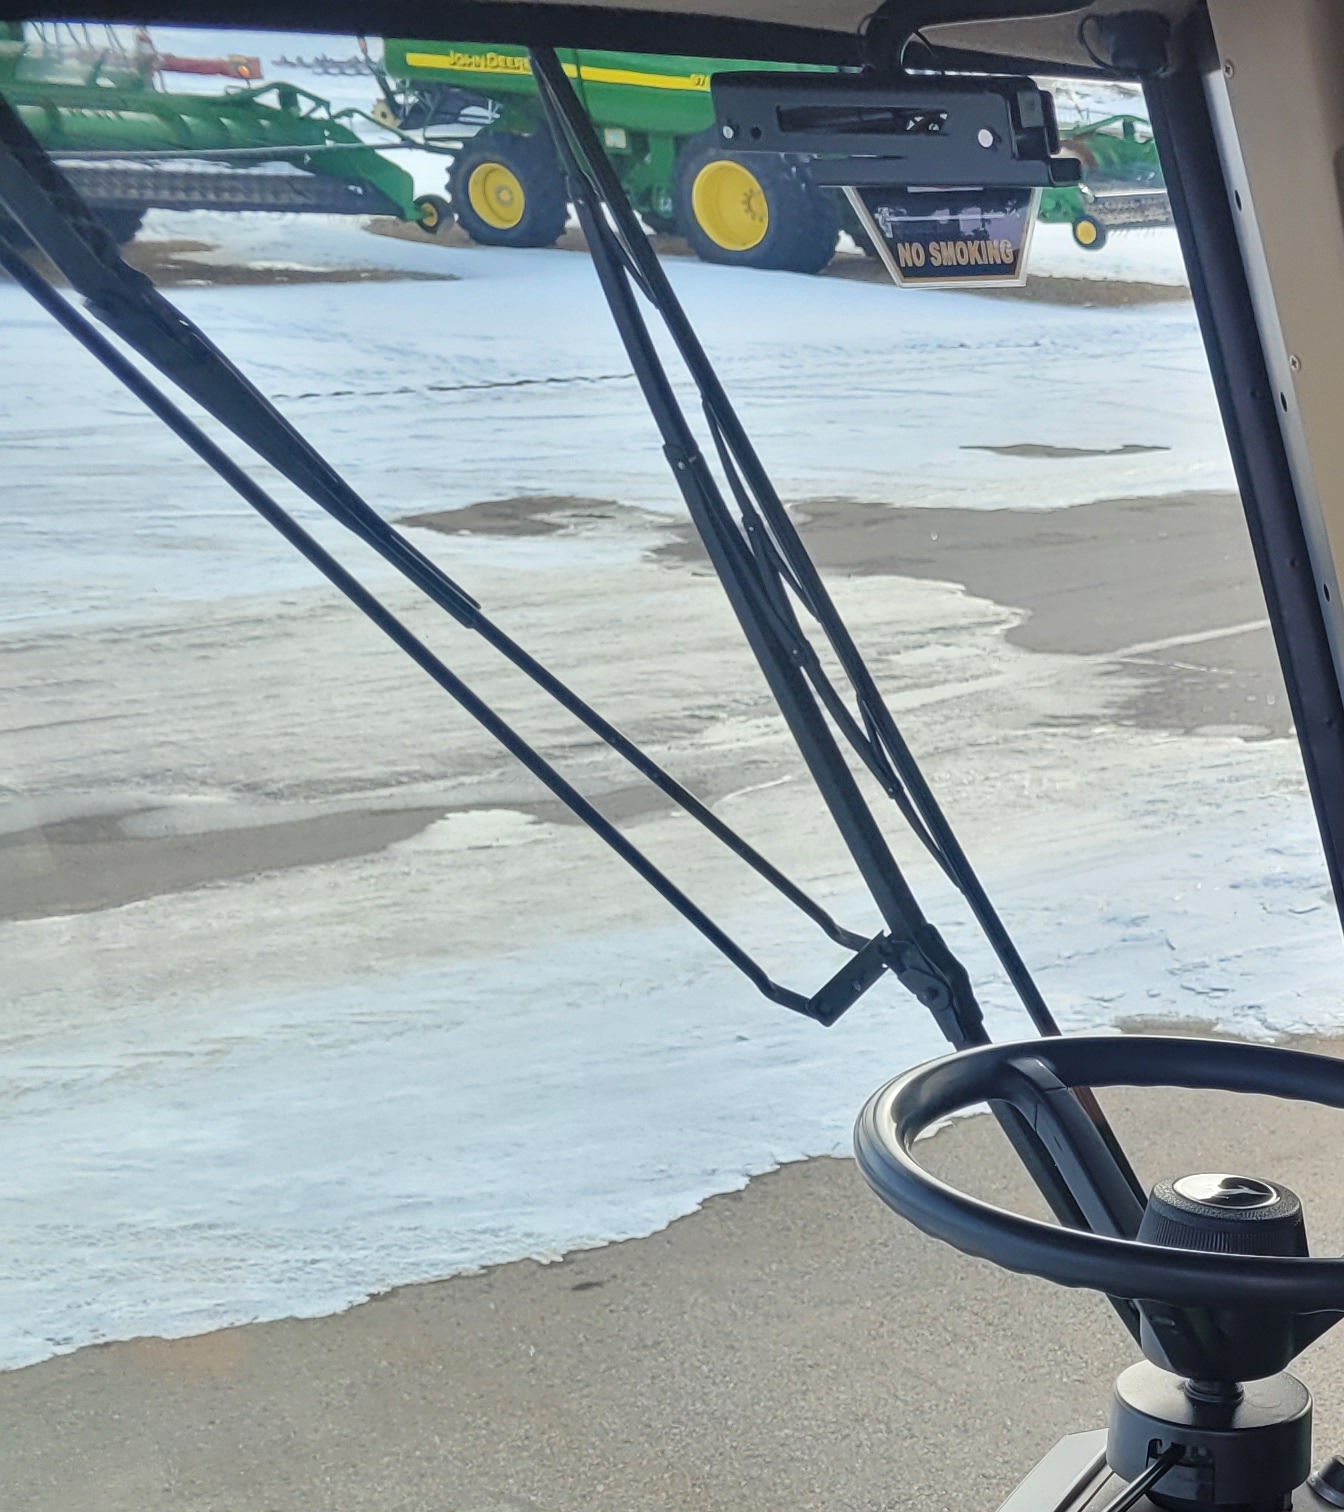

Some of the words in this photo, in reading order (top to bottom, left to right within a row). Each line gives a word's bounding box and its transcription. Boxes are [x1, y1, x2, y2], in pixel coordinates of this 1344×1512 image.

[450, 50, 484, 68] JOHN
[897, 242, 926, 267] NO
[929, 239, 1014, 266] SMOKING
